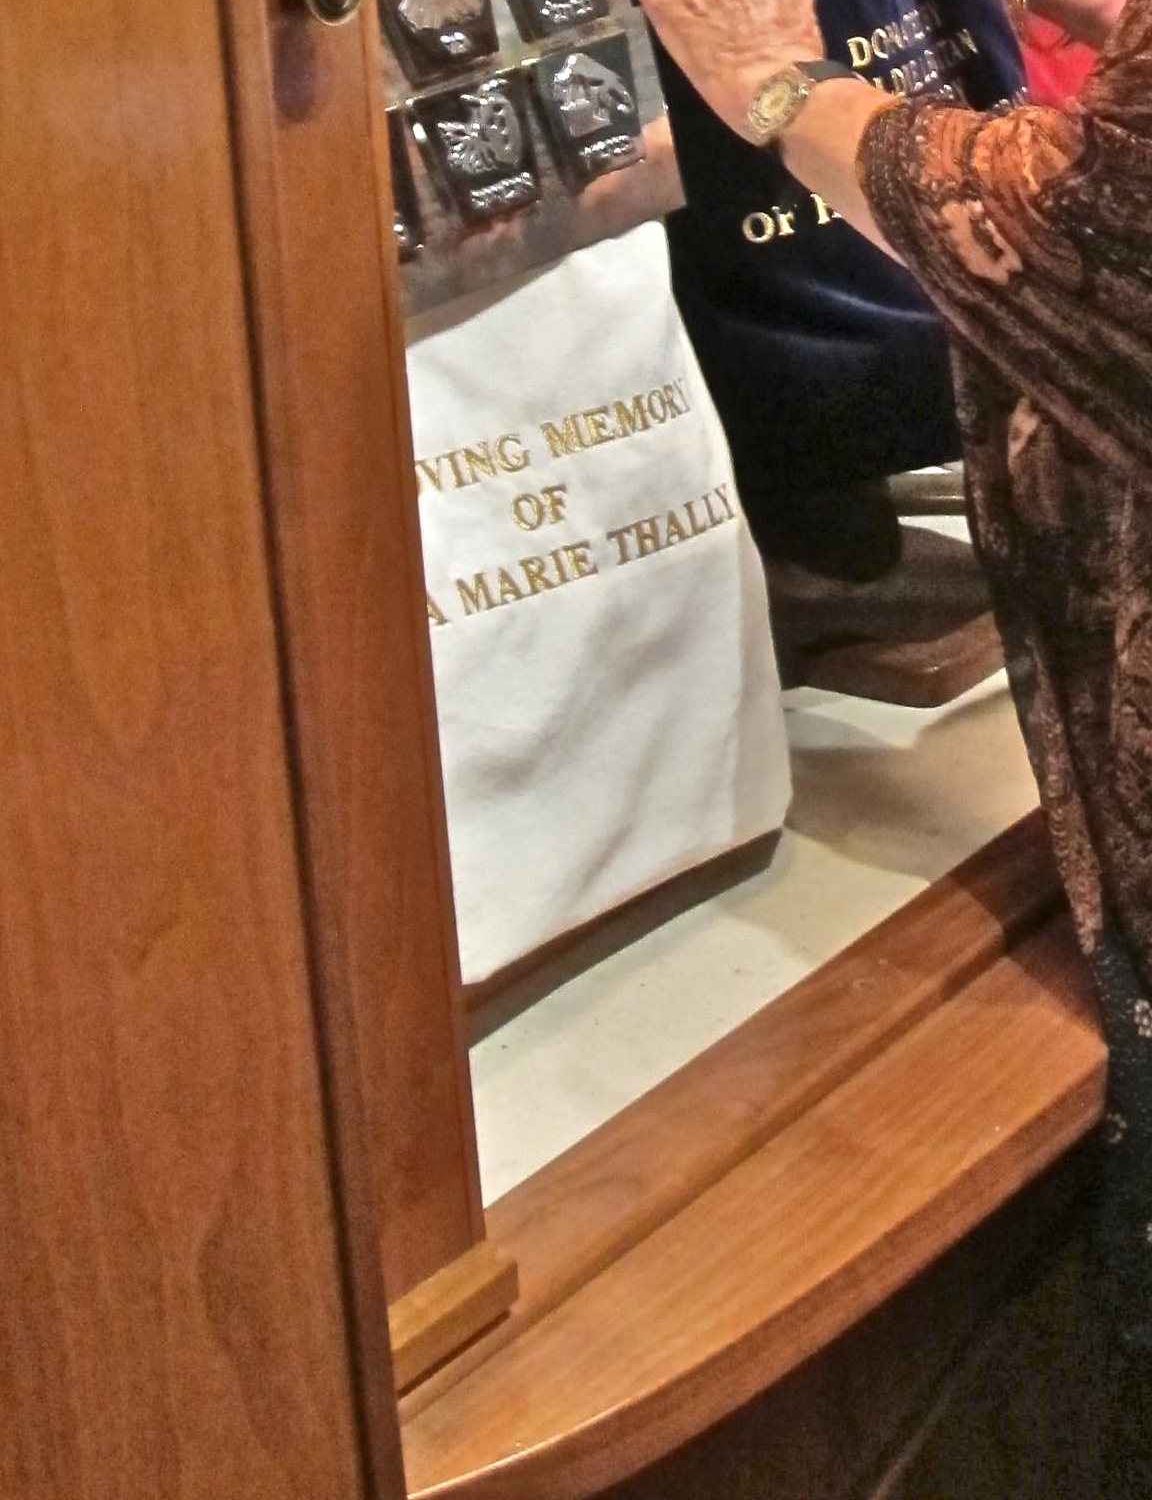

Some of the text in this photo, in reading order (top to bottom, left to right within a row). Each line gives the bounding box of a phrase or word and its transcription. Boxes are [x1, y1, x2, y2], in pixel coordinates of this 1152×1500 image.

[415, 376, 691, 493] VING MEMORY
[455, 541, 599, 617] MARIE
[606, 482, 736, 567] THALLY
[511, 483, 568, 532] OF
